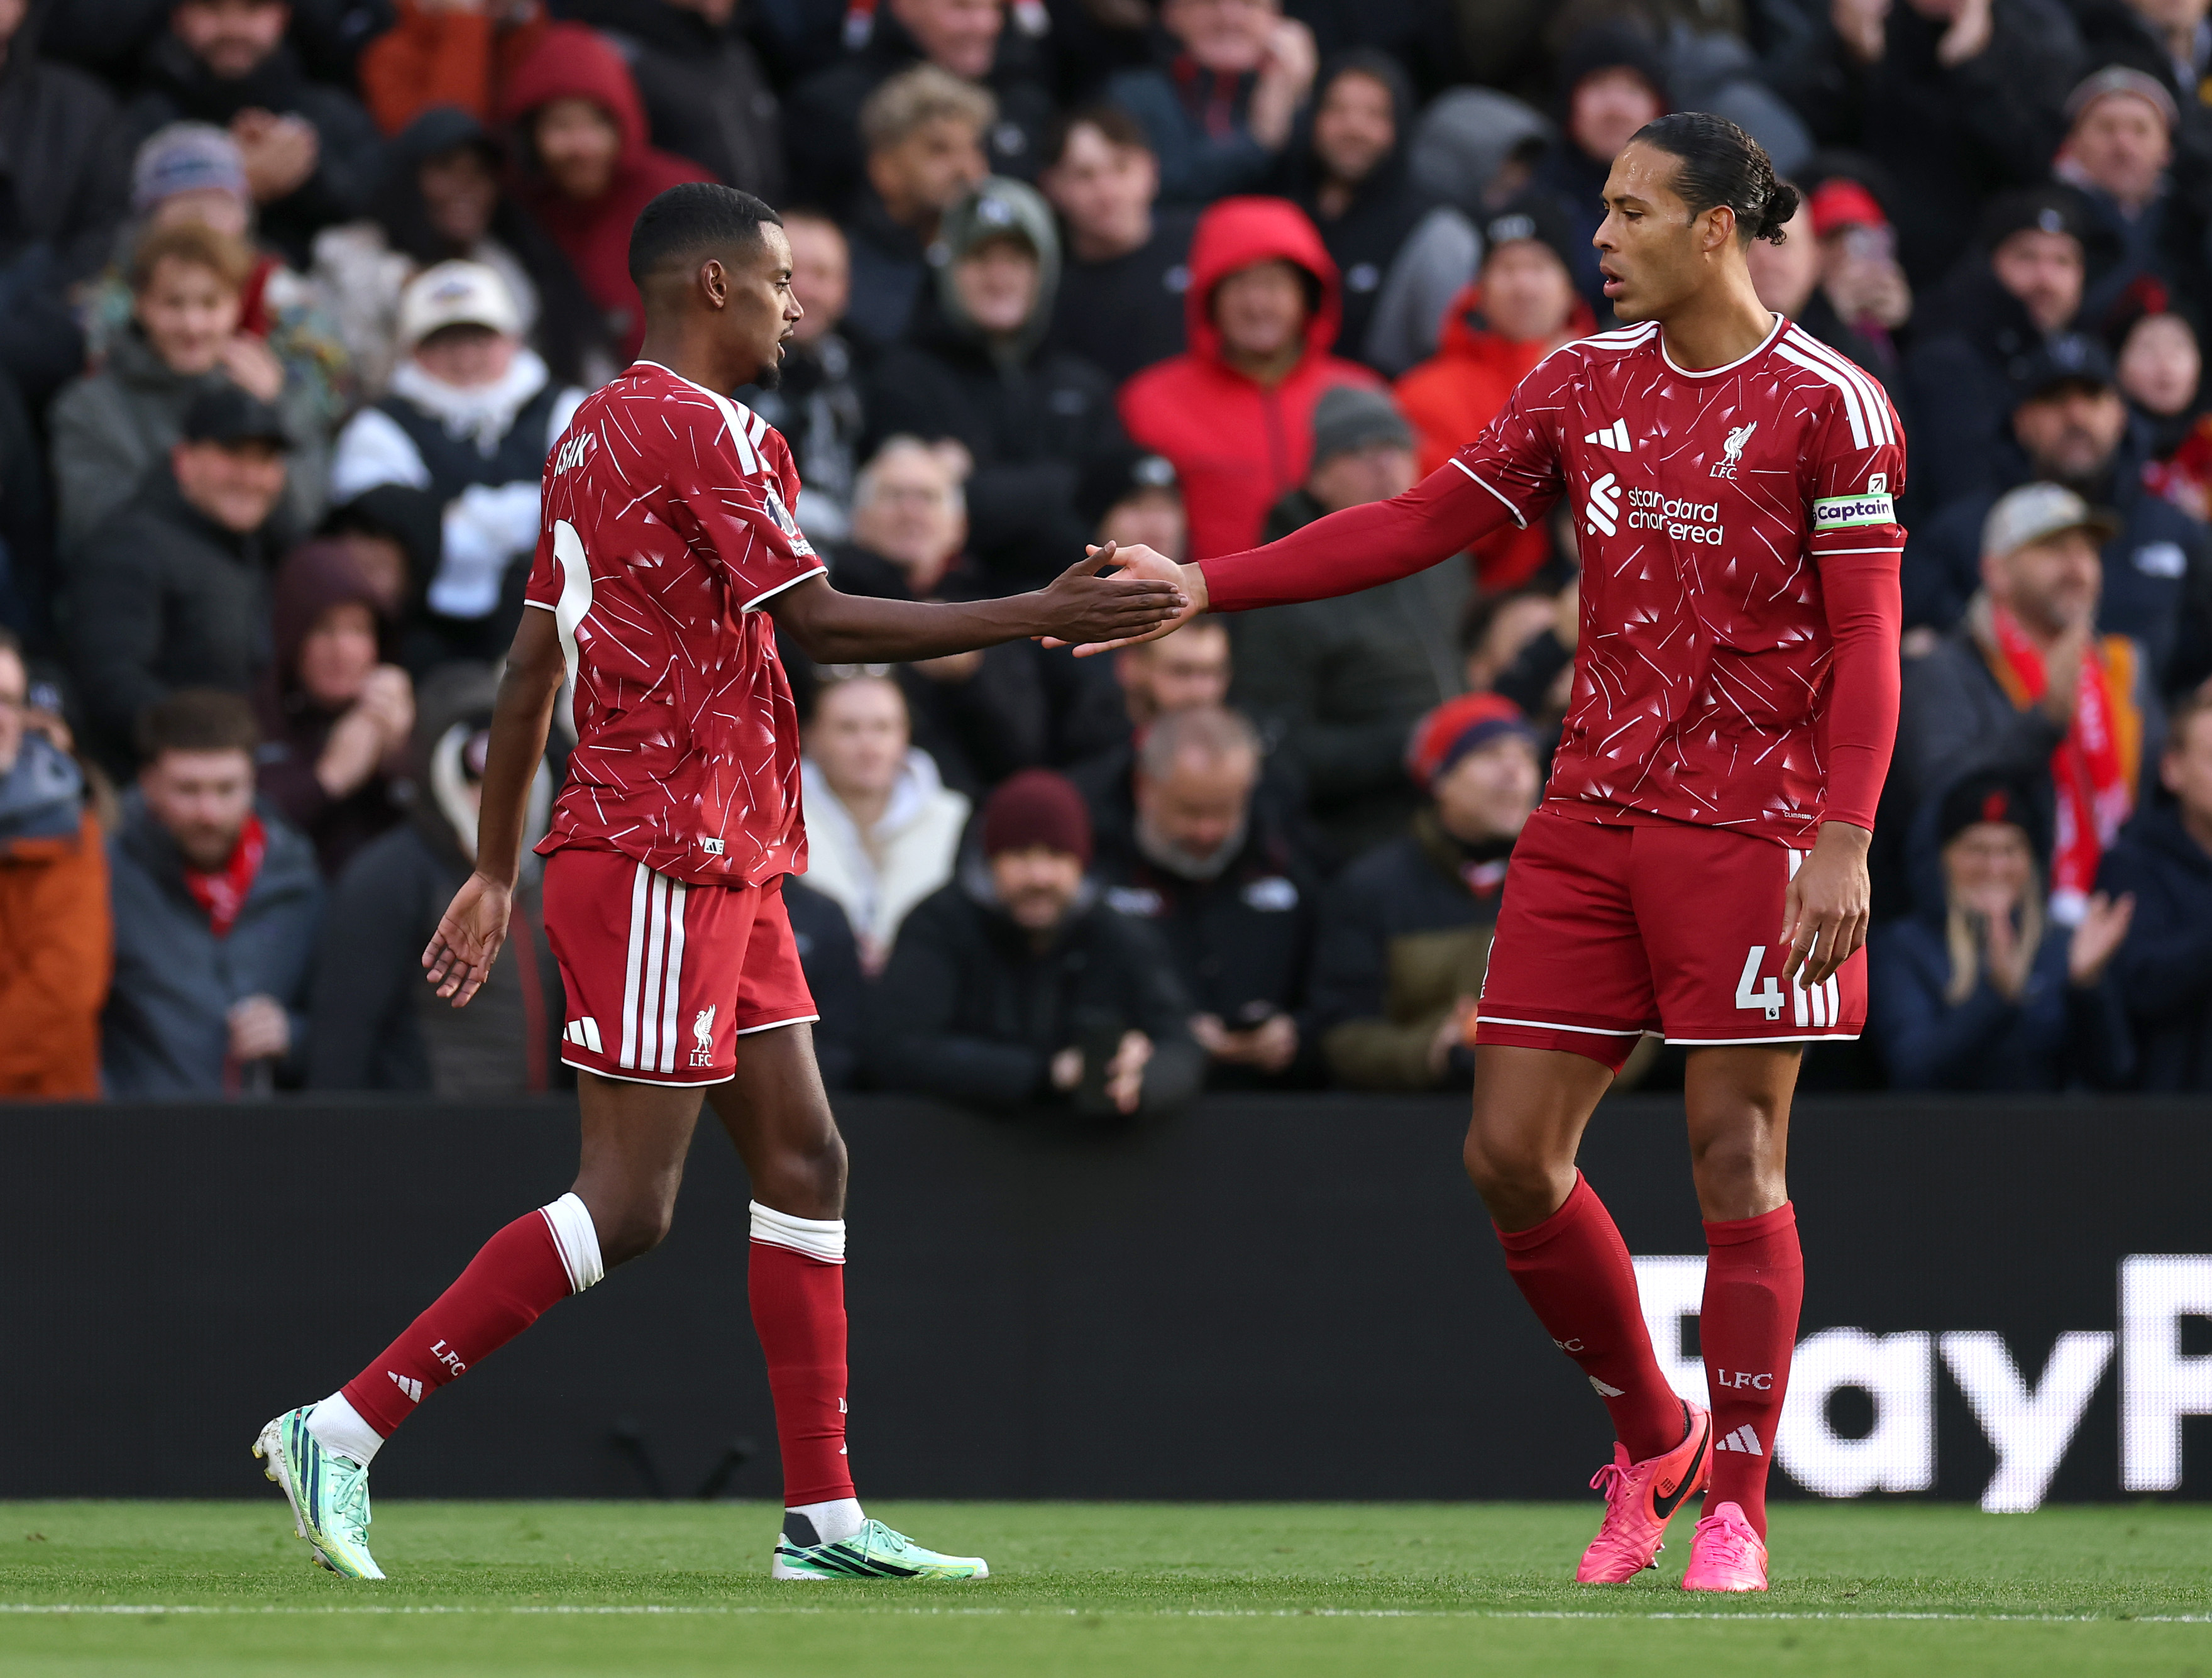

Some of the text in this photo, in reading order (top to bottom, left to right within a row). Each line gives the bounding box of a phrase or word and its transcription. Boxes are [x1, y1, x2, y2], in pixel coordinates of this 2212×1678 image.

[554, 432, 594, 478] ISAK
[1628, 486, 1718, 522] standard
[1736, 946, 1785, 1020] 4
[429, 1339, 466, 1376] LFC
[1718, 1369, 1773, 1390] LFC
